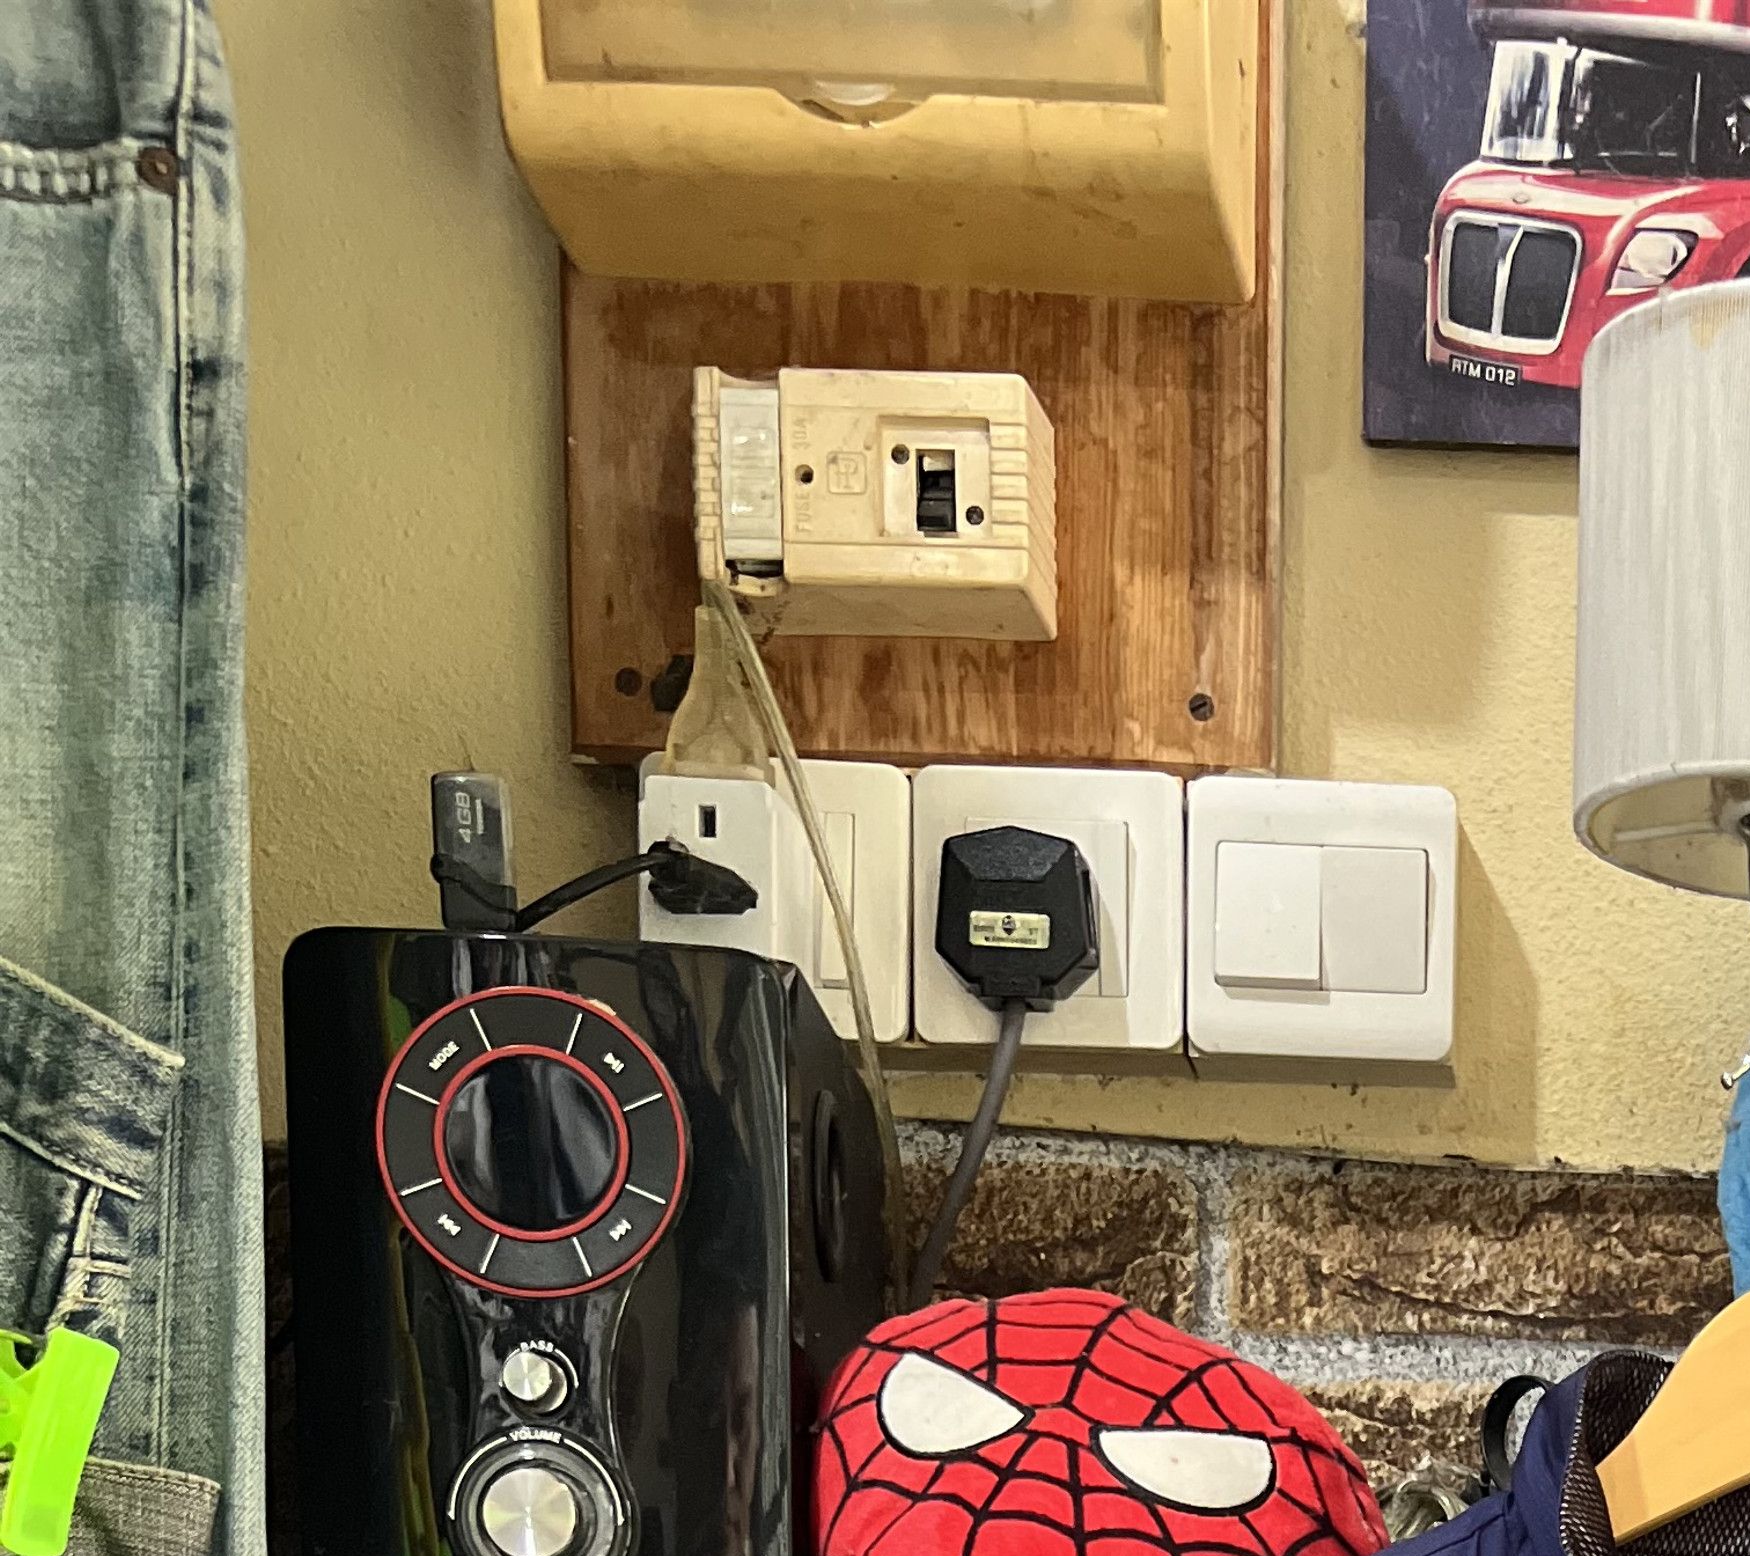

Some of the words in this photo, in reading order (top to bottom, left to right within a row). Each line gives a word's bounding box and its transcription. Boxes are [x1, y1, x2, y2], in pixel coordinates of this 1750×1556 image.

[454, 791, 472, 845] 4GB
[428, 1040, 461, 1072] MODE
[519, 1338, 555, 1354] BASS
[508, 1425, 563, 1445] VOLUME
